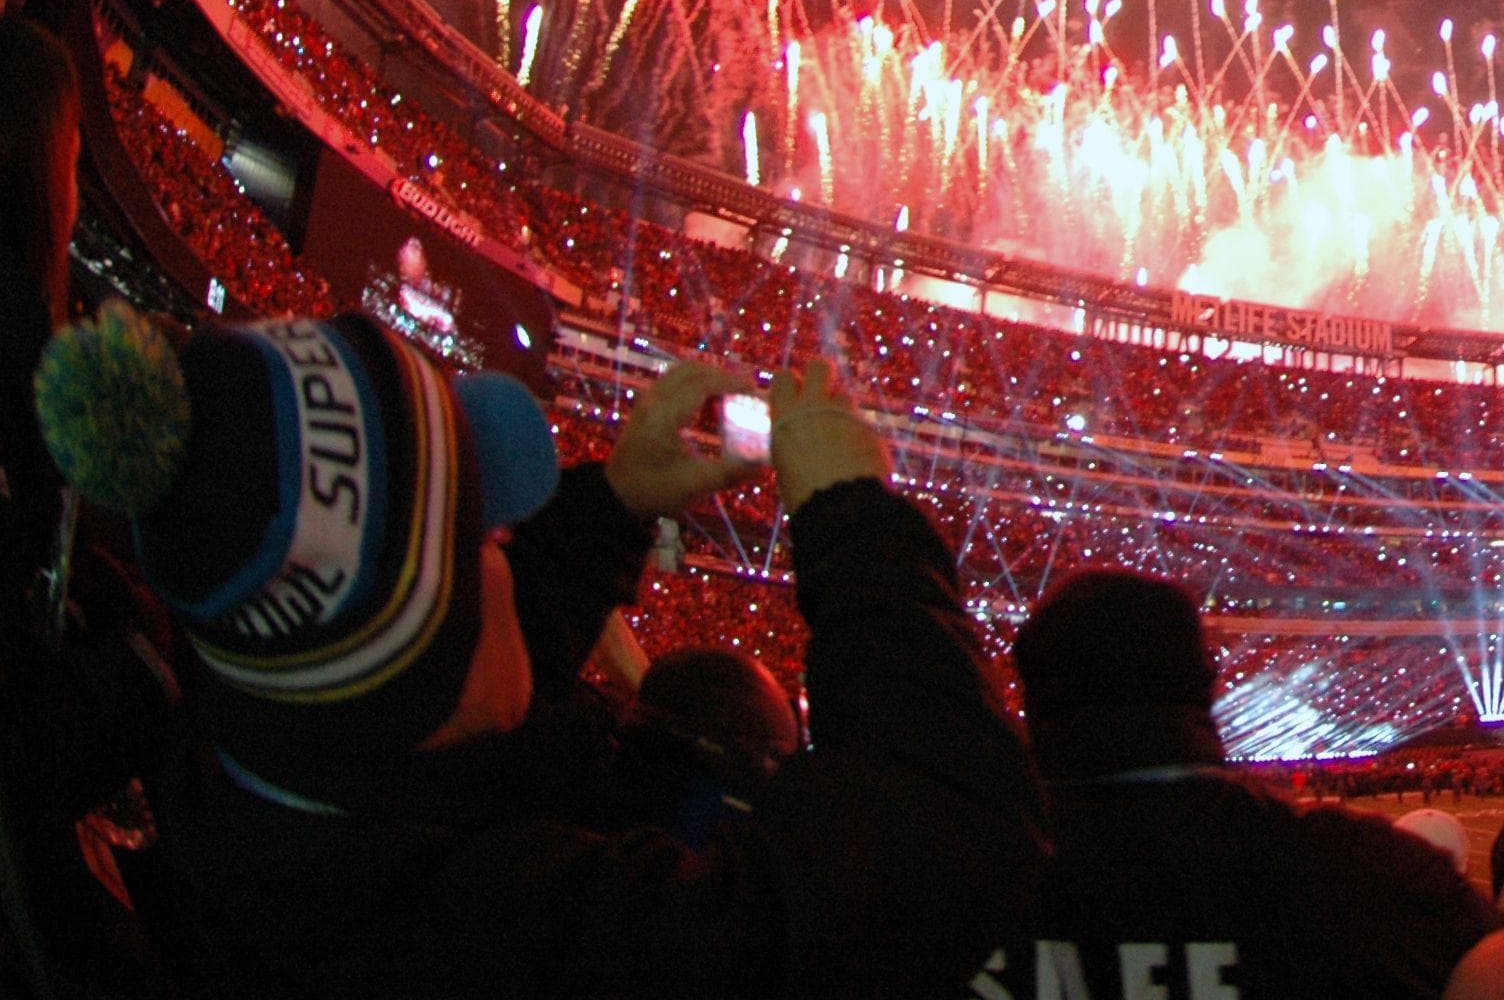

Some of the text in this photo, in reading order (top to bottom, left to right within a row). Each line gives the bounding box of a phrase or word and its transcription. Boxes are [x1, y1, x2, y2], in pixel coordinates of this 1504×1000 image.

[399, 181, 483, 248] BUD LIGHT
[1284, 309, 1394, 353] STADIUM
[264, 319, 361, 526] SUPER
